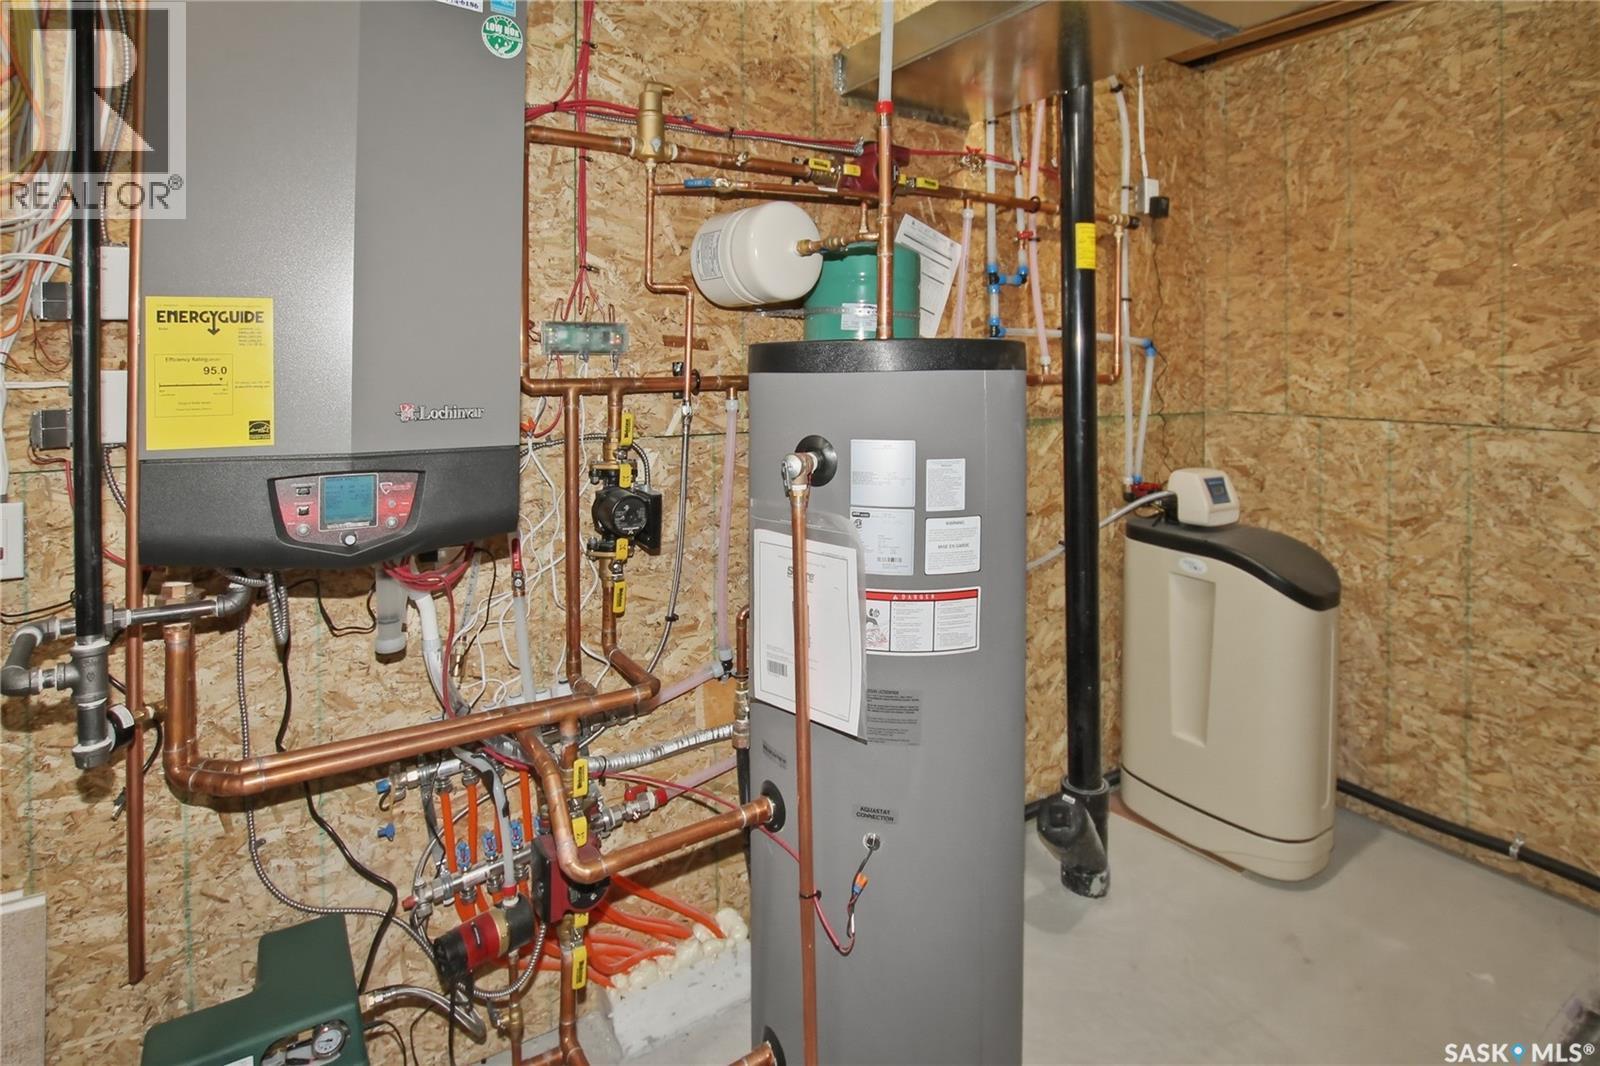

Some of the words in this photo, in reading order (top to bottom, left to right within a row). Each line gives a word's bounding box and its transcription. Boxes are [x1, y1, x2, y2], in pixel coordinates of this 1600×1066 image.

[157, 310, 264, 324] ENERGYGUIDE
[203, 366, 228, 375] 95.0
[419, 405, 485, 420] Lochinvar
[855, 811, 894, 821] CONNECTION
